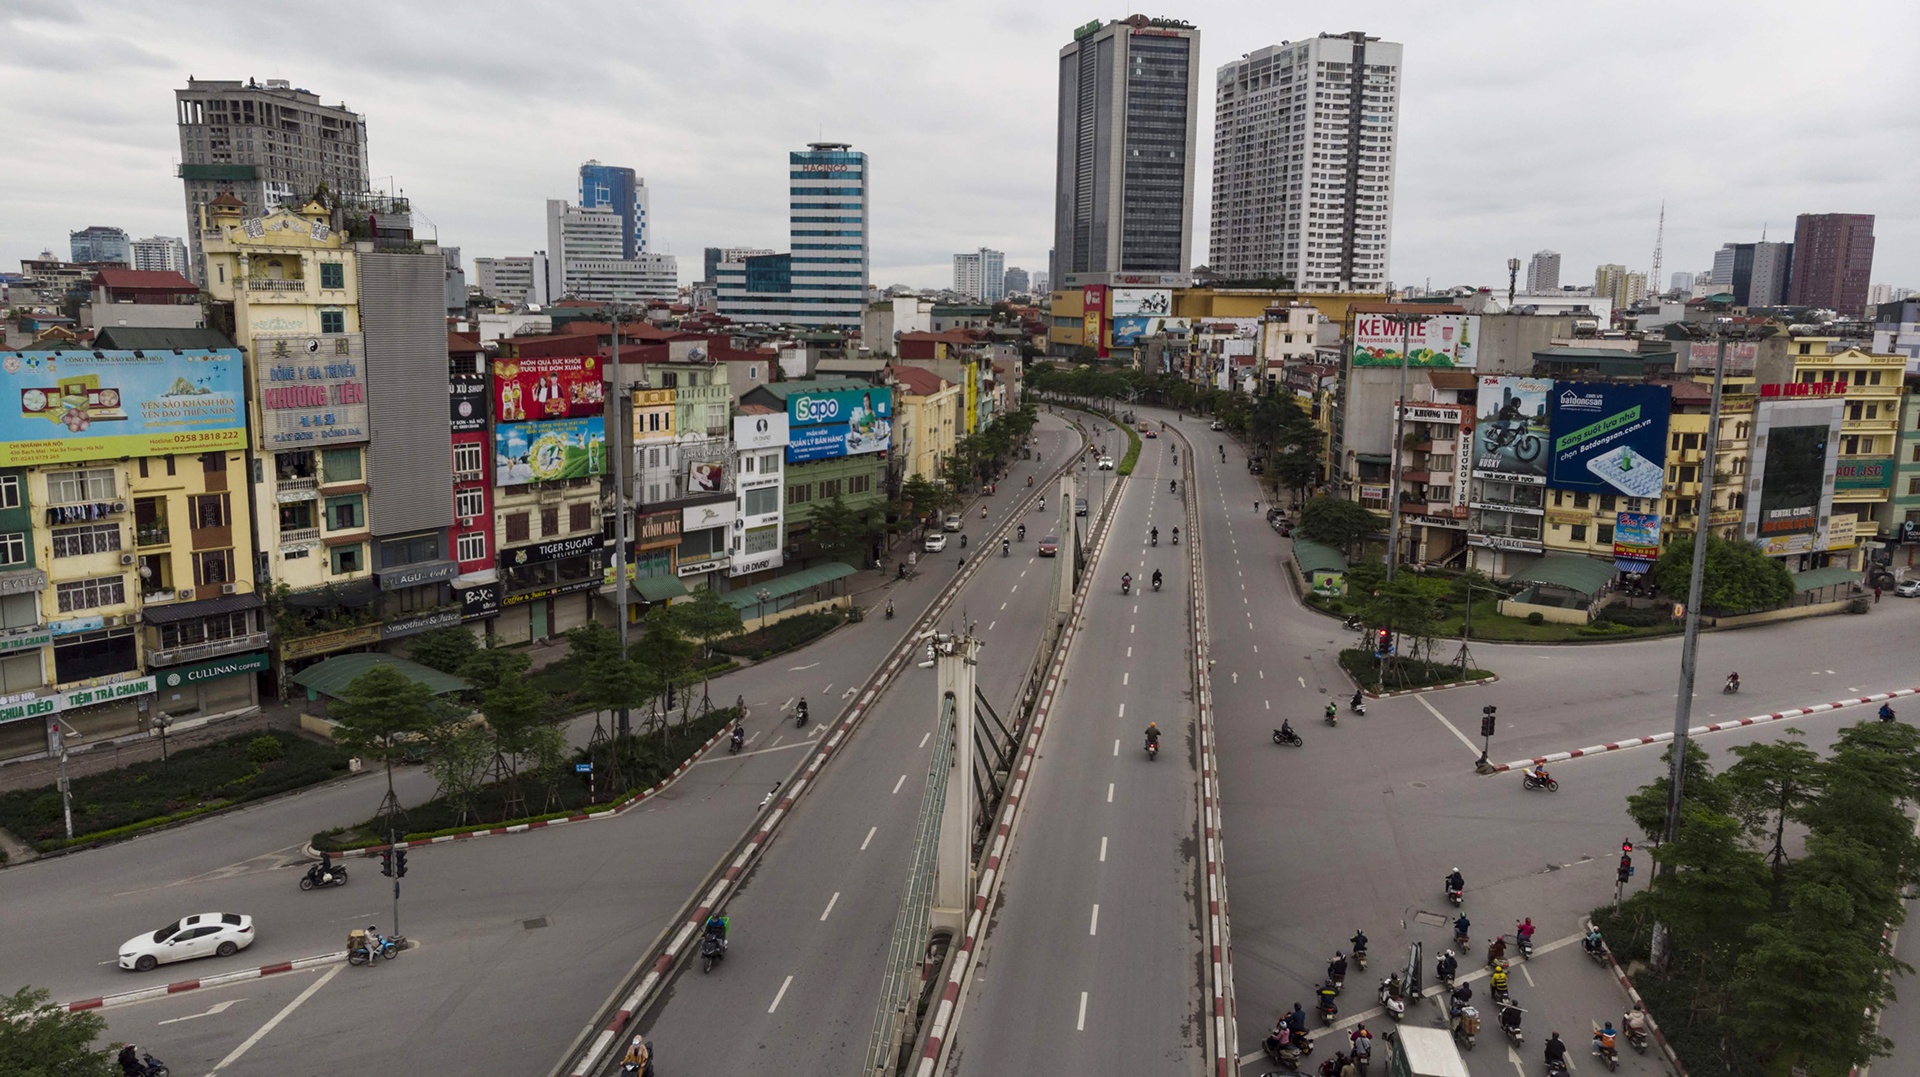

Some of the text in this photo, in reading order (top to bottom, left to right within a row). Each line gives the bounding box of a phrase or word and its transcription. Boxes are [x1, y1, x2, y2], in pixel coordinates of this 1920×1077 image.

[796, 396, 839, 423] Sapo
[174, 434, 197, 443] 0258
[199, 432, 221, 441] 3818
[222, 430, 239, 439] 222
[1860, 465, 1882, 476] JSC
[539, 537, 593, 555] TIGER SUGAR
[552, 550, 583, 559] DELIVERY
[24, 635, 50, 645] CHANH
[188, 661, 262, 681] CULLINAN COFFEE
[68, 681, 149, 707] TIỆM TRÀ CHANH
